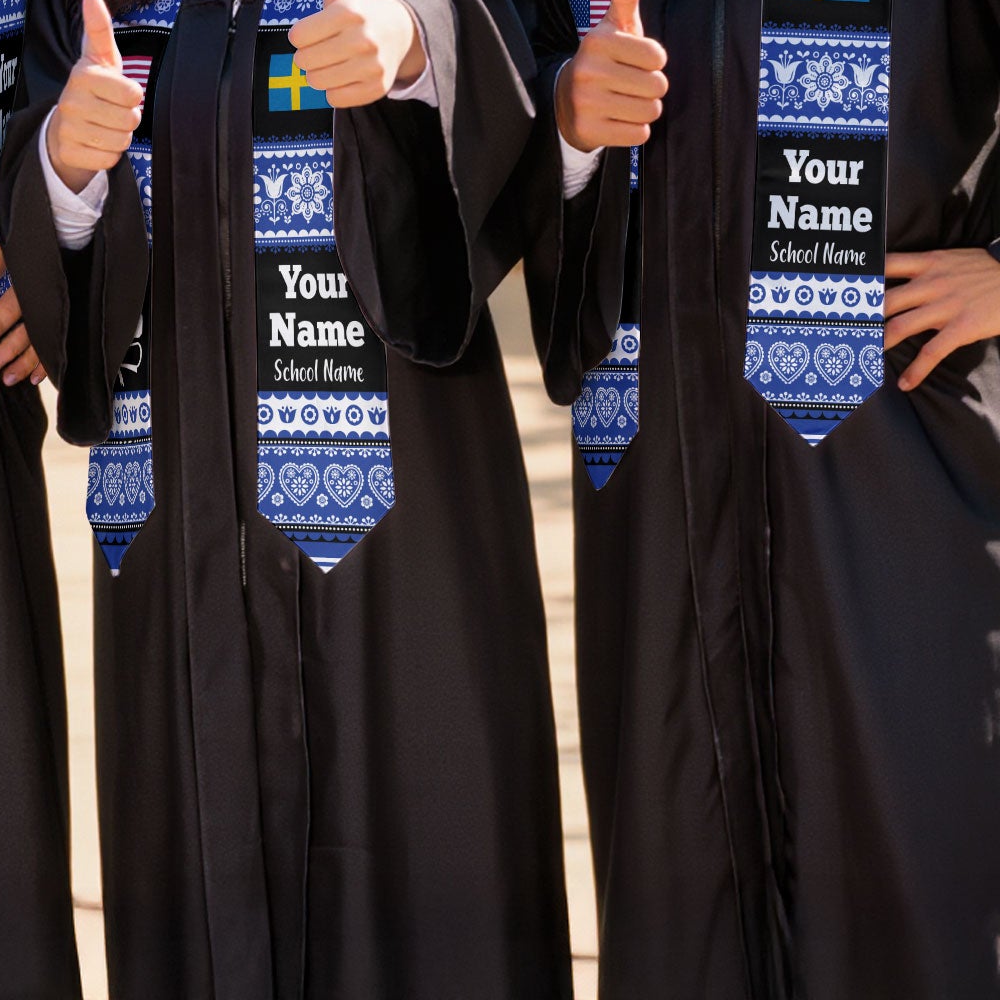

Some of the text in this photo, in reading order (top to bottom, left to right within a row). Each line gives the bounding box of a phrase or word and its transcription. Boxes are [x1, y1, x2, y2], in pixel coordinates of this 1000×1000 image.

[783, 149, 864, 186] Your
[767, 195, 873, 233] Name
[769, 240, 866, 266] School Name
[278, 265, 348, 300] Your
[269, 312, 365, 348] Name
[273, 358, 365, 383] School Name
